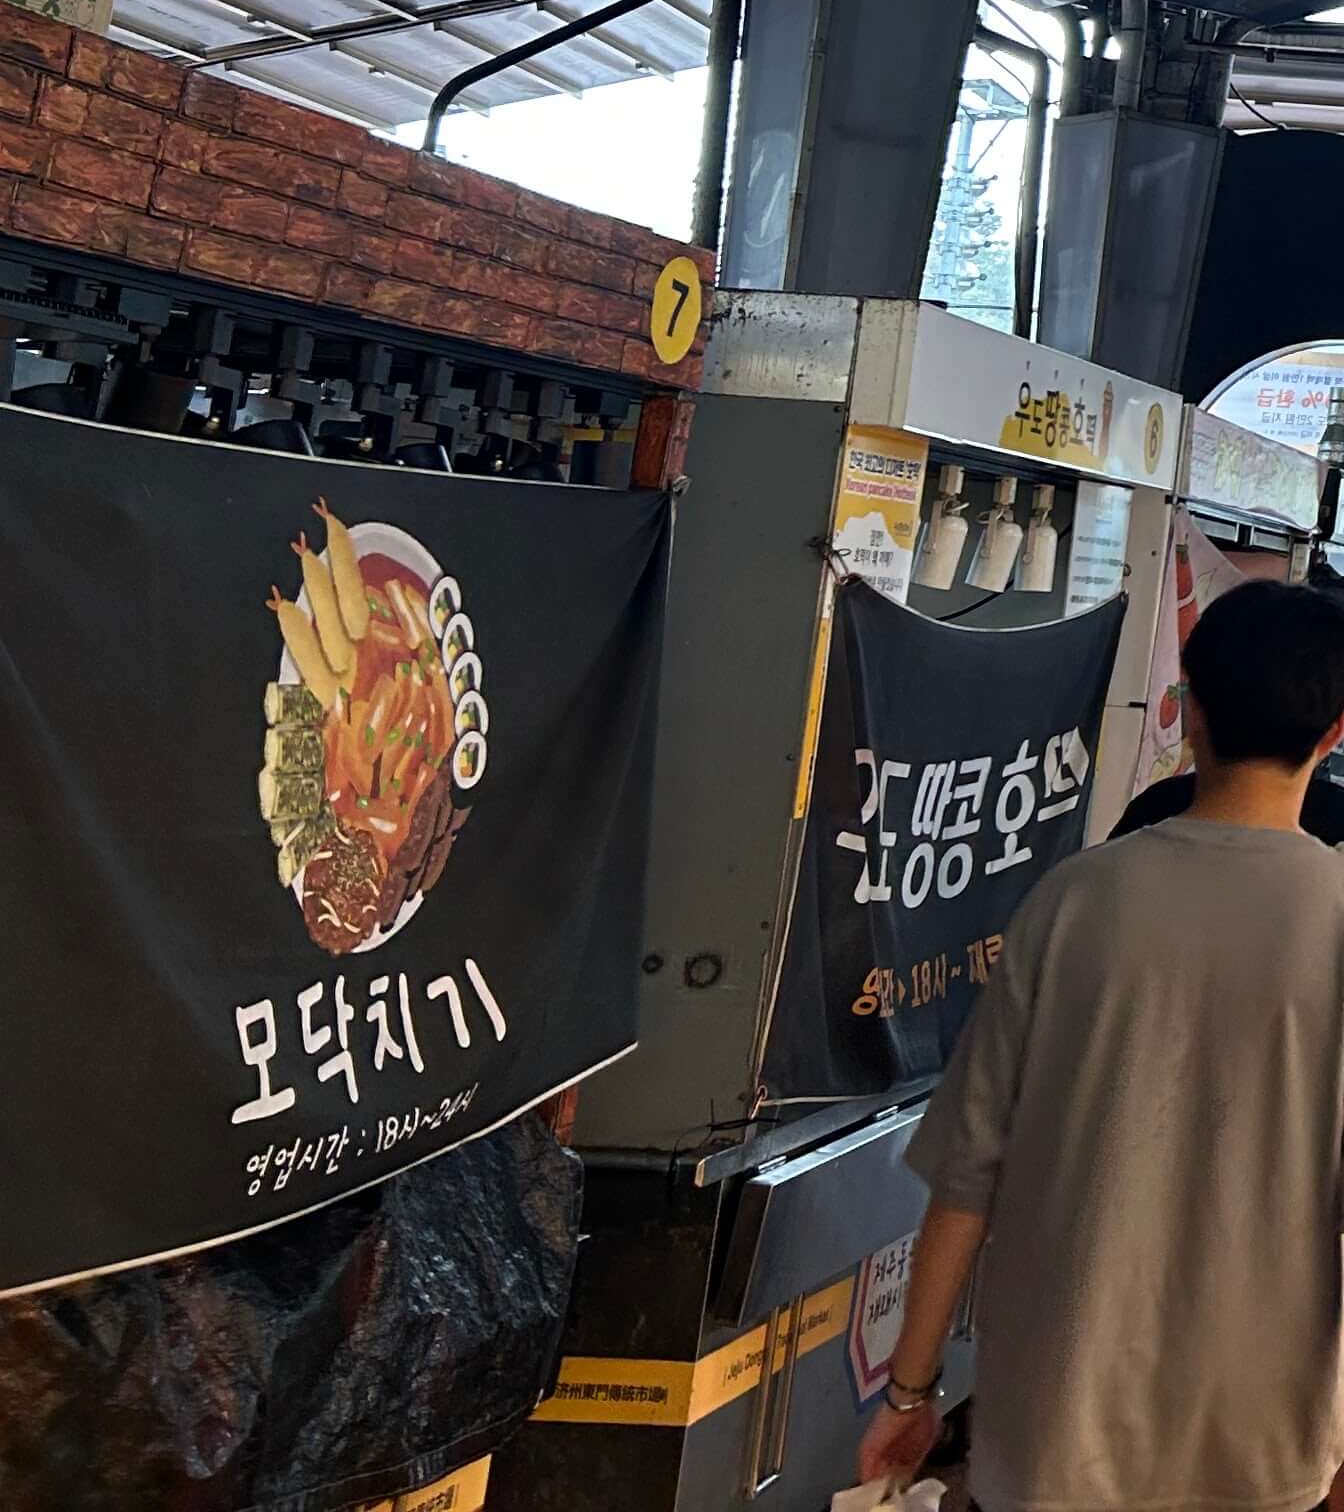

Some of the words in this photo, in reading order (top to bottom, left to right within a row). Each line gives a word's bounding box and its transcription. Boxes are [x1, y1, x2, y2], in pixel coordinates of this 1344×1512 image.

[667, 278, 689, 338] 7
[1149, 419, 1160, 458] 6
[232, 957, 506, 1125] 모닥치기
[246, 1125, 349, 1197] 영업시간
